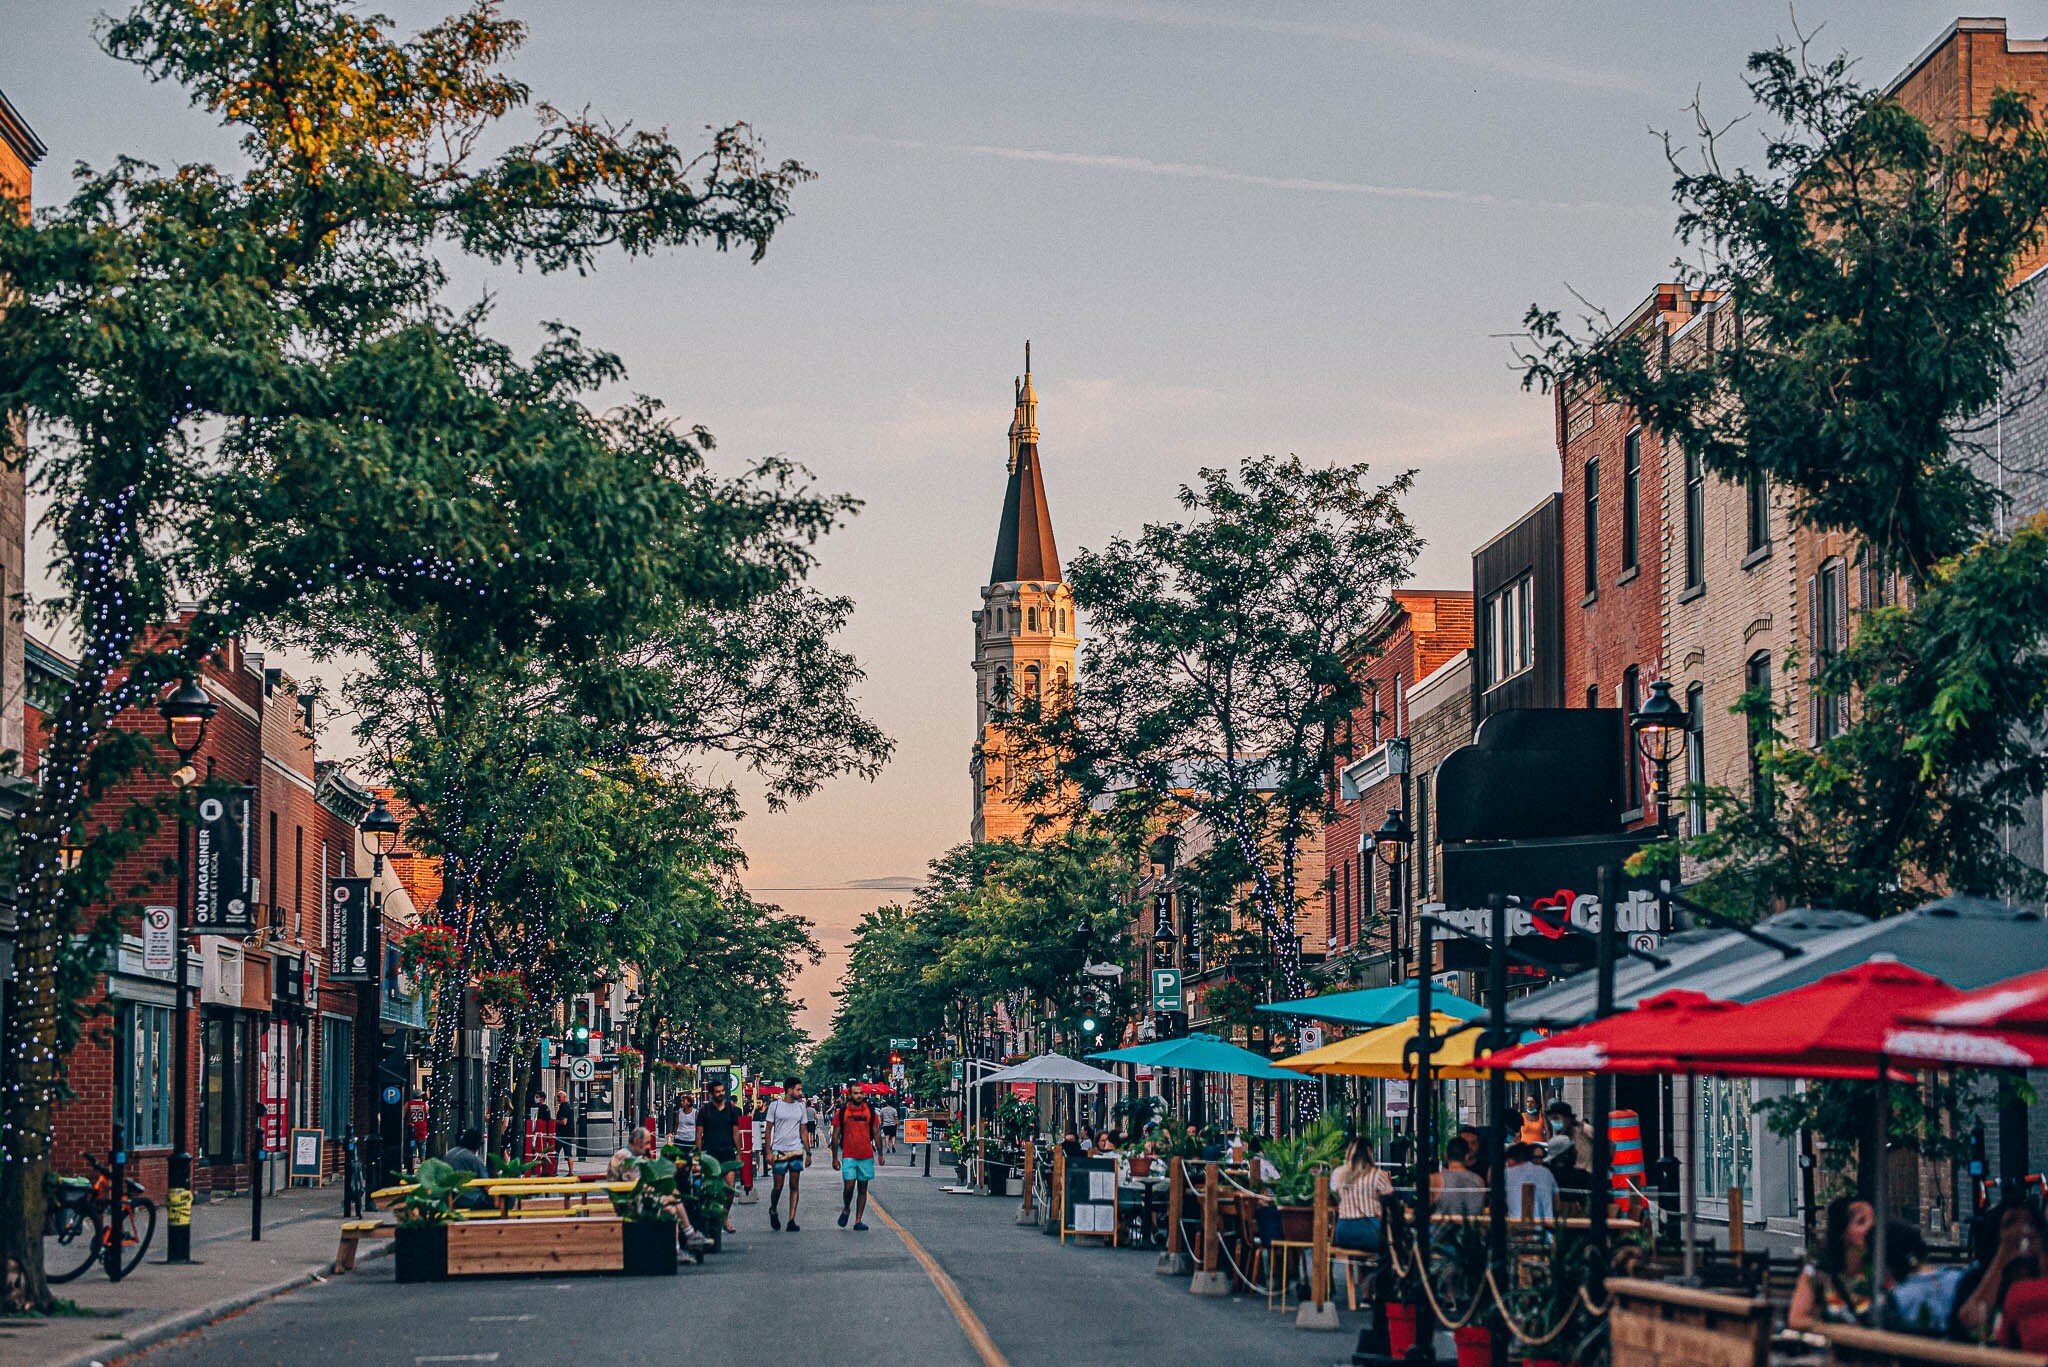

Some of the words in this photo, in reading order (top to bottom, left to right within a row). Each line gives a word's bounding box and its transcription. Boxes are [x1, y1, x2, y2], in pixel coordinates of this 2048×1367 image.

[198, 829, 211, 902] MAGASINER
[211, 851, 220, 878] LOCAL
[211, 880, 219, 890] ET
[196, 904, 209, 923] OÙ
[210, 891, 218, 922] UNIQUE
[333, 903, 342, 939] SERVICE
[332, 941, 341, 973] ESPACE
[1158, 973, 1175, 994] P
[890, 1038, 898, 1048] P
[703, 1065, 727, 1073] COMMERCES
[387, 1089, 396, 1102] P
[410, 1111, 425, 1122] 23
